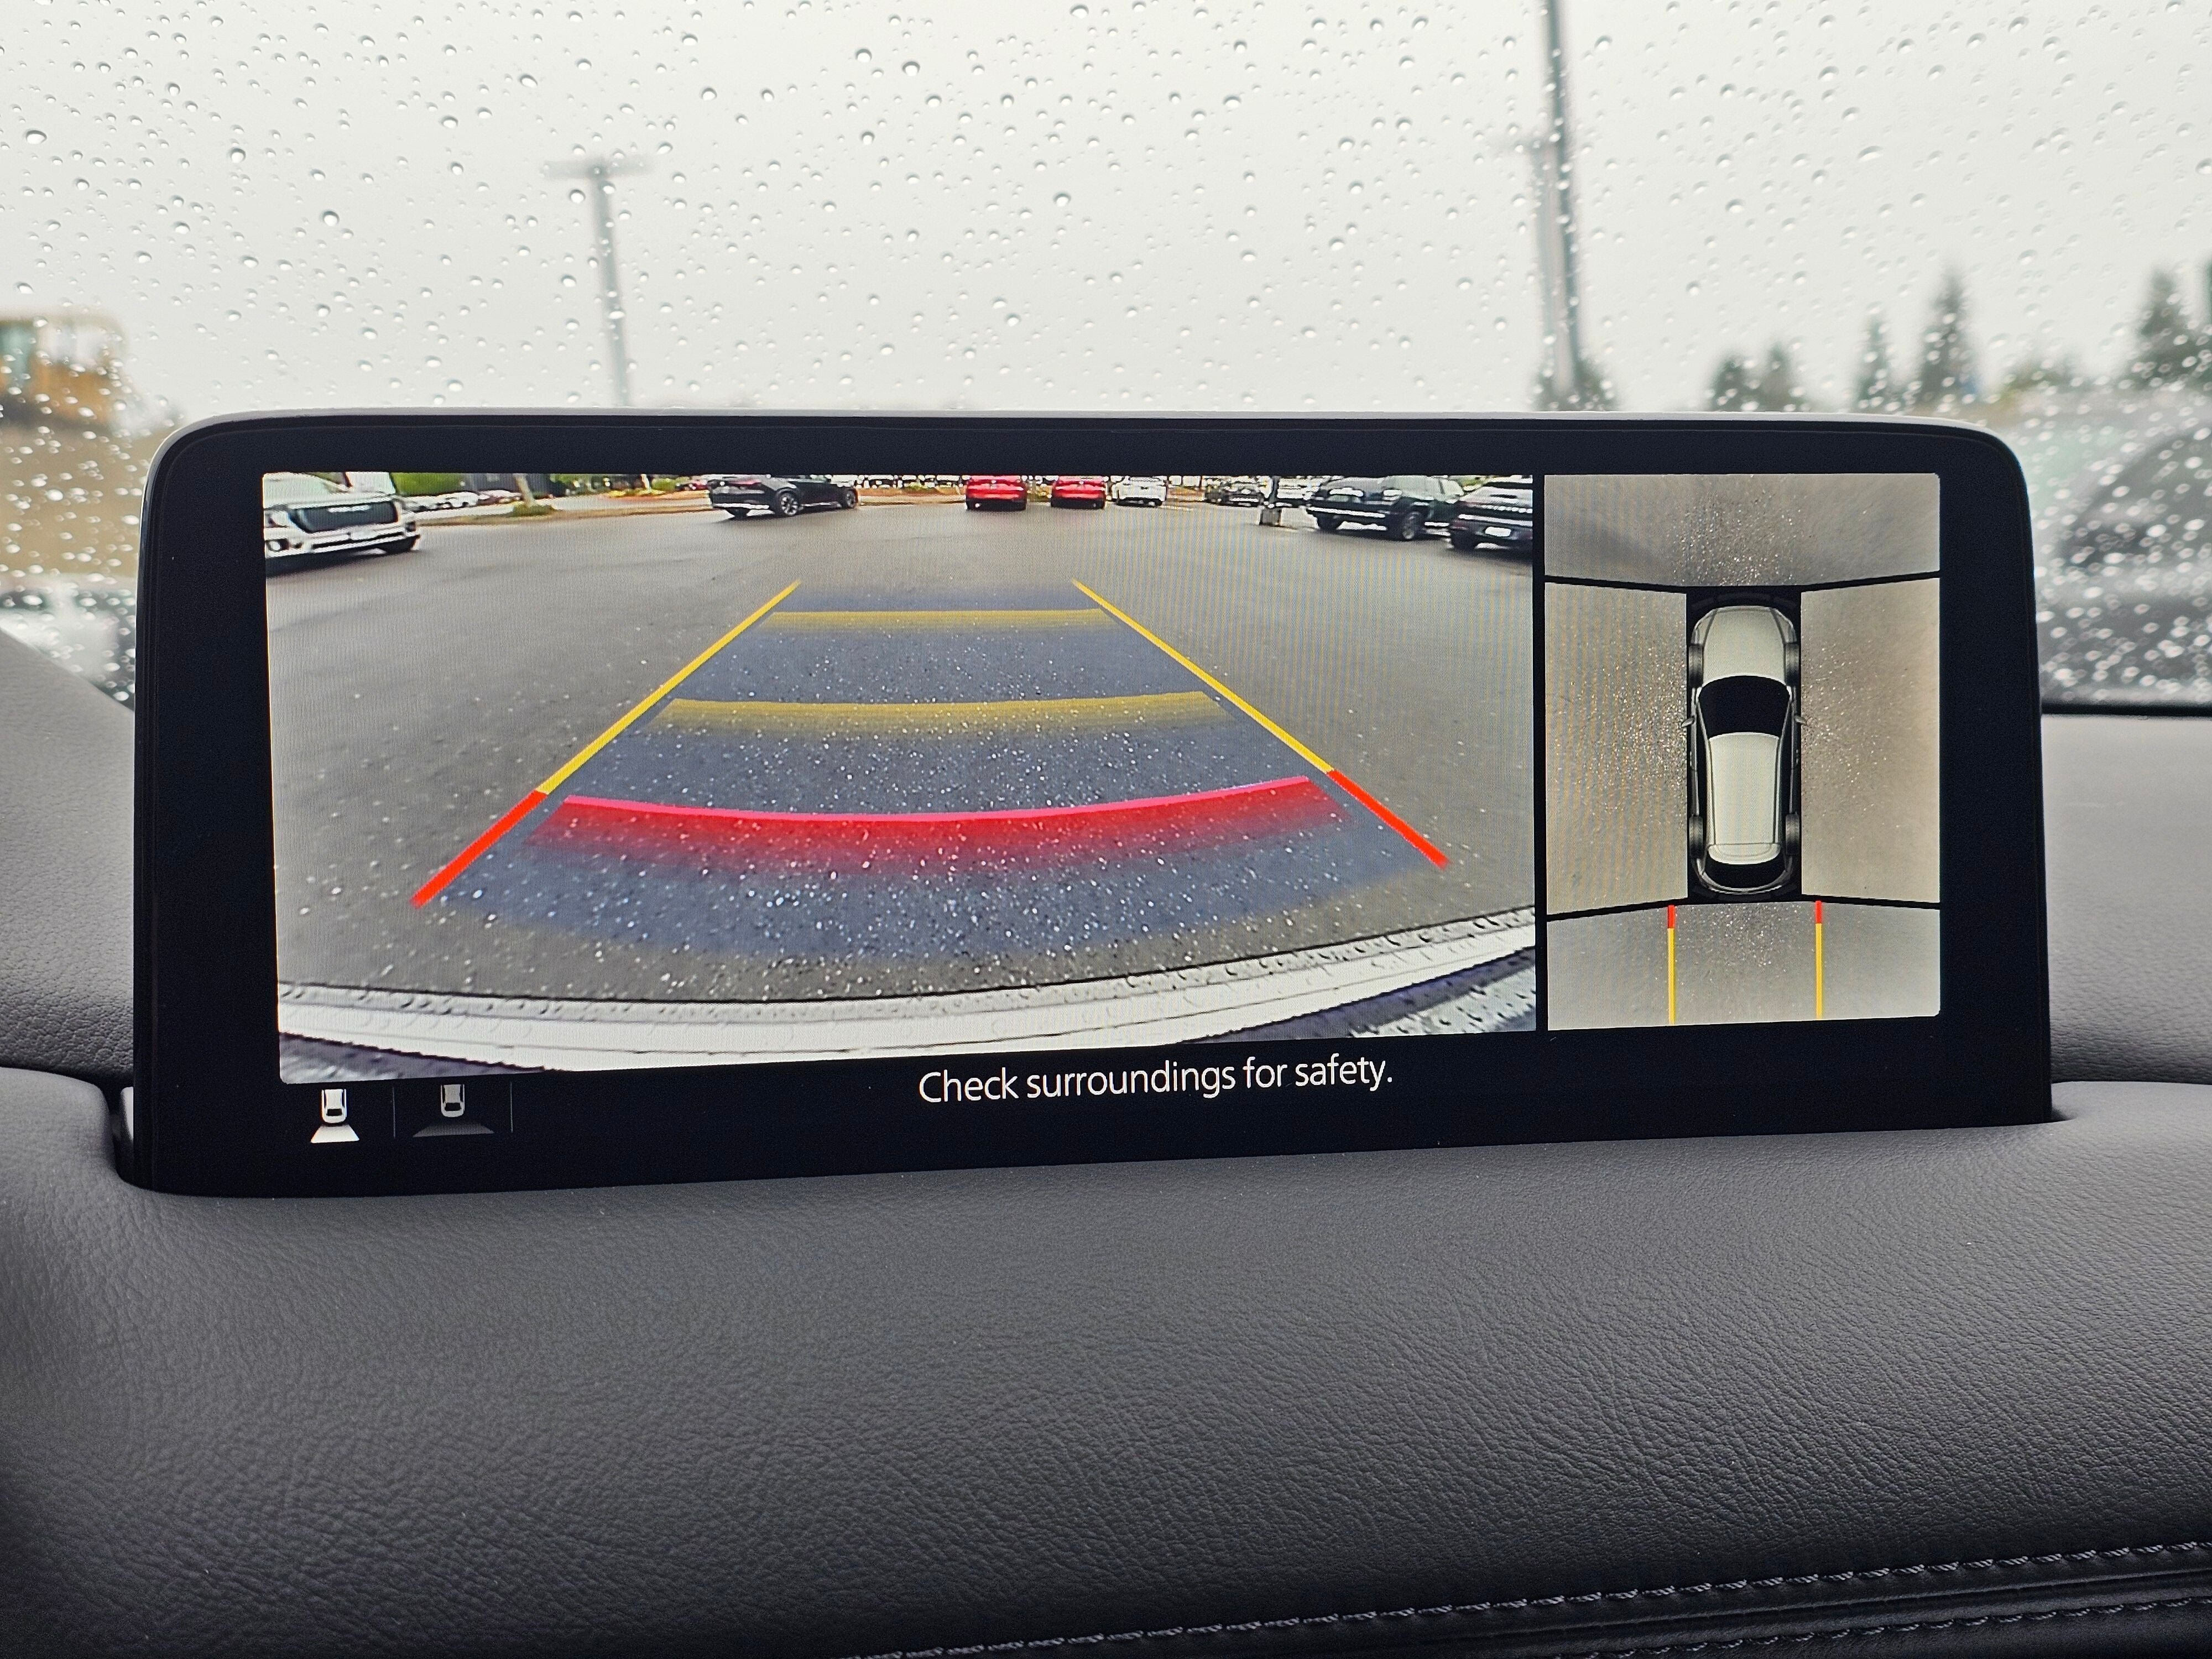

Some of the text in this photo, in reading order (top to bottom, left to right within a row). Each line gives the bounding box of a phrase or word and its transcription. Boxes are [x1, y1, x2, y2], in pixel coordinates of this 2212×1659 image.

[919, 1052, 1393, 1103] Check surroundings for safety.
